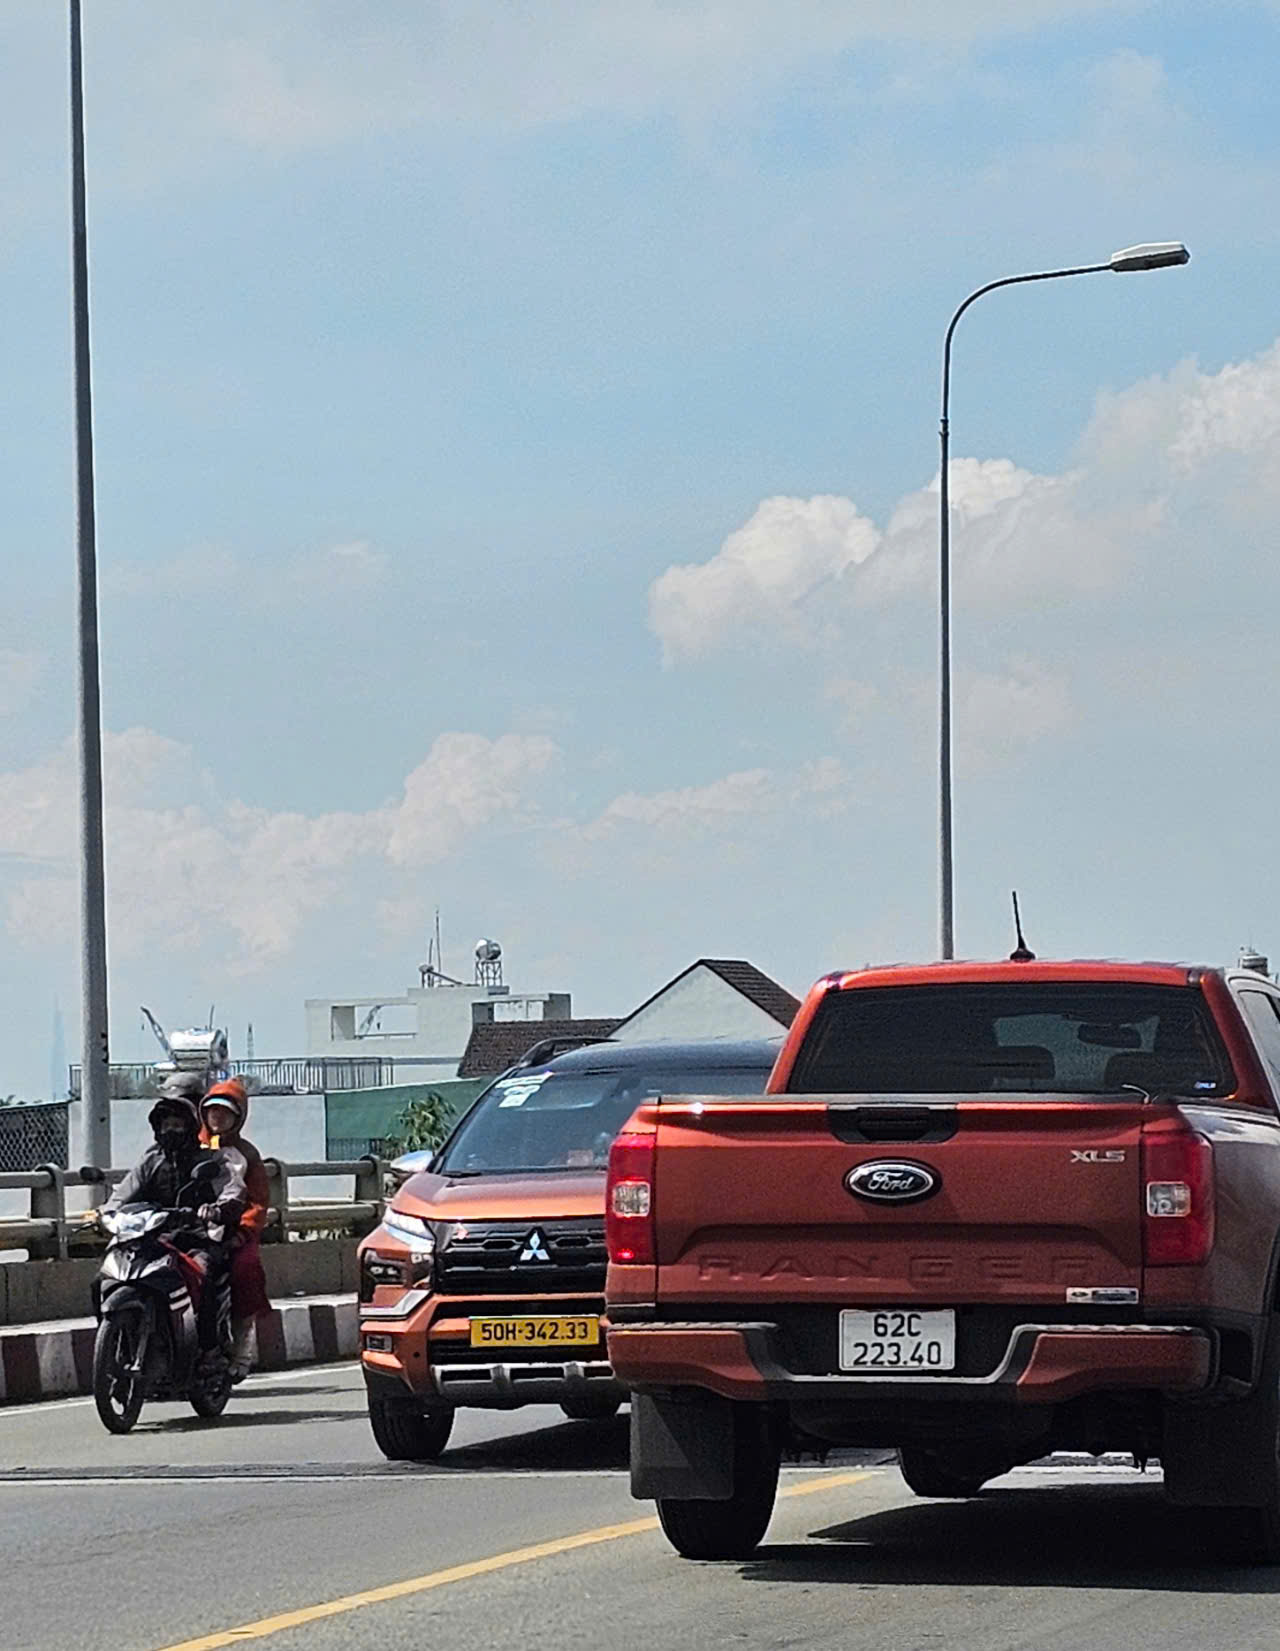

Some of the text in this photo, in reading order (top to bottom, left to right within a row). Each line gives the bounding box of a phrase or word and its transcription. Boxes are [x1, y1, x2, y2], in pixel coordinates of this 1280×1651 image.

[1070, 1150, 1125, 1162] XLS
[867, 1171, 914, 1190] Ford
[698, 1255, 1095, 1281] RANGER
[481, 1322, 588, 1340] 50H-342.33
[873, 1313, 921, 1337] 62C
[853, 1341, 941, 1365] 223.40
